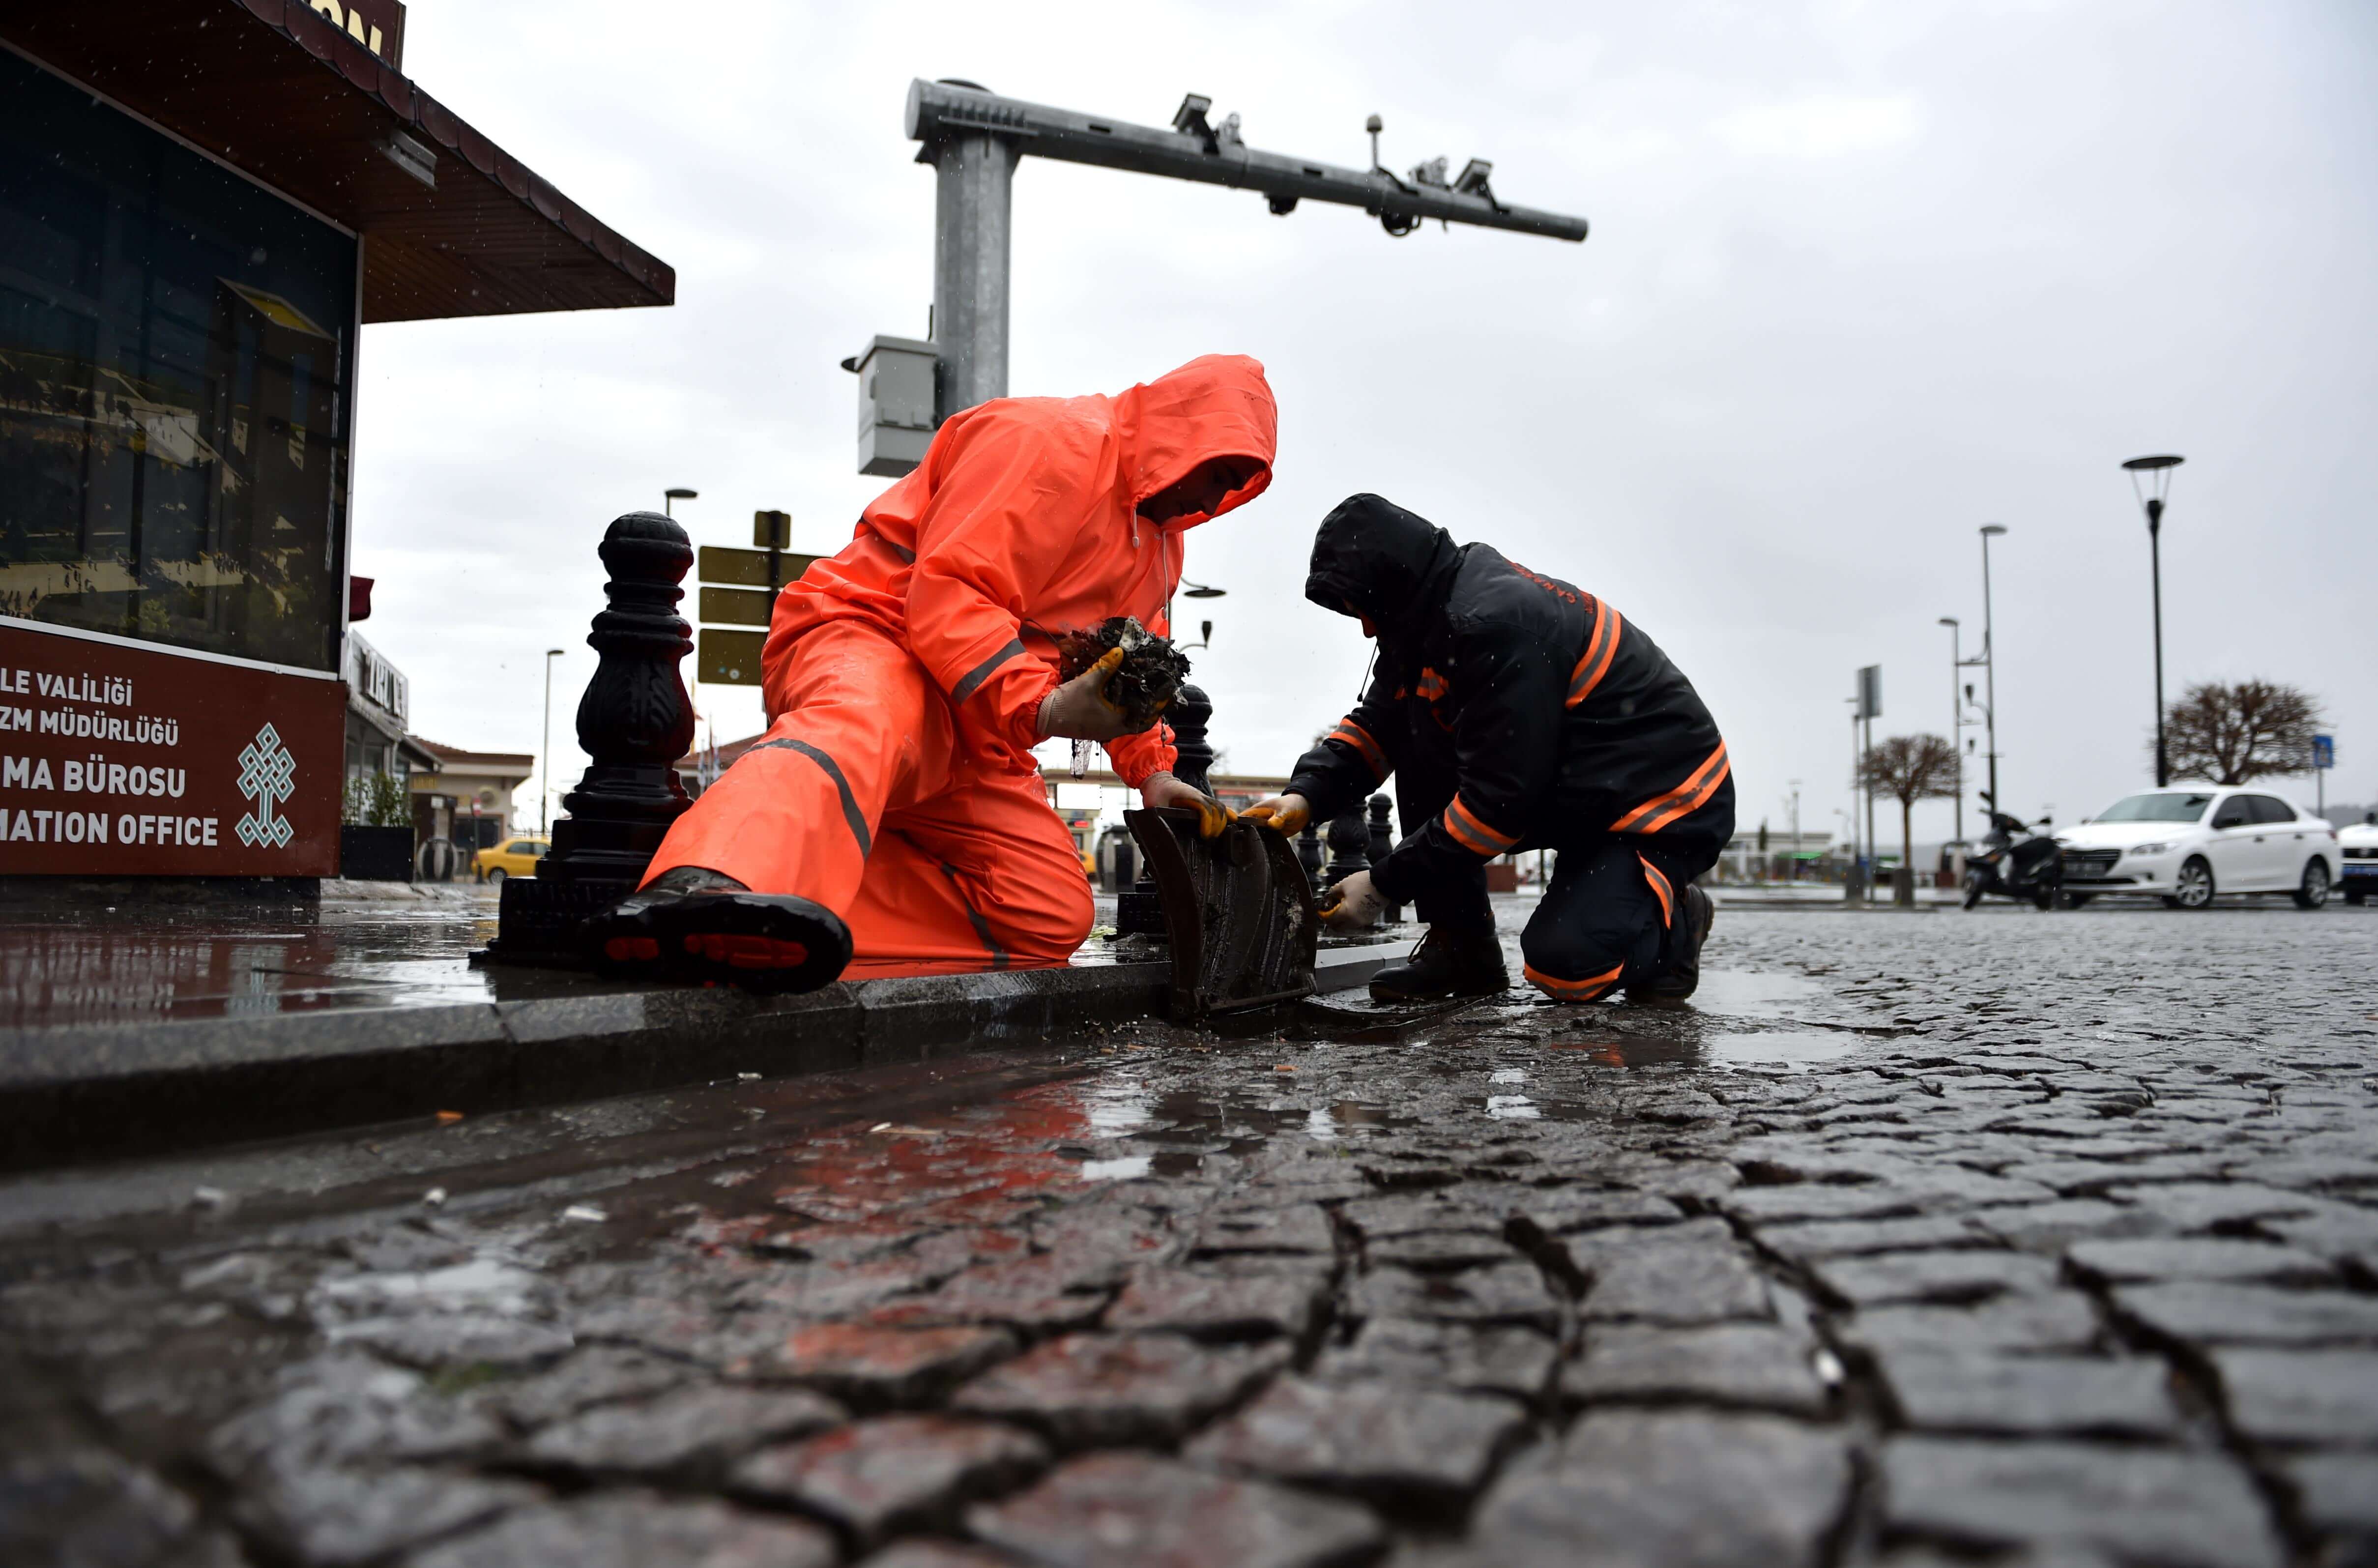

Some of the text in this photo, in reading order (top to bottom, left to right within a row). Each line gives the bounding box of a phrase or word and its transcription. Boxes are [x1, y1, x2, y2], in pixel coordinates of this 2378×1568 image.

[37, 672, 132, 706] VALİLİĞİ
[40, 706, 178, 746] MÜDÜRLÜĞÜ
[3, 754, 185, 798] MA BÜROSU
[118, 814, 218, 846] OFFICE
